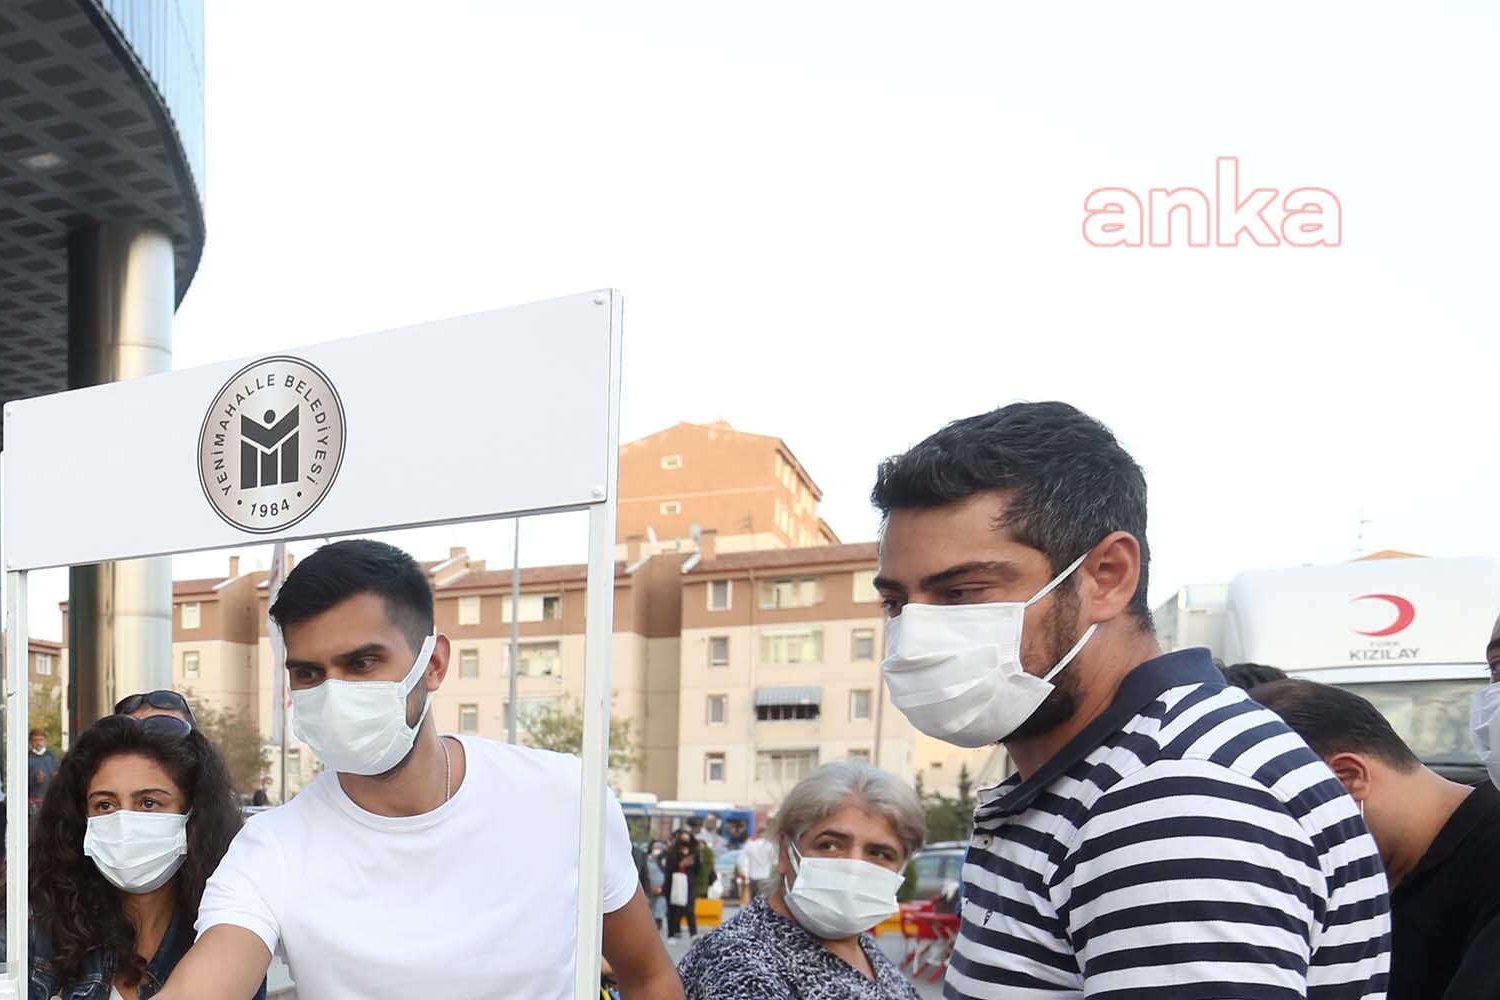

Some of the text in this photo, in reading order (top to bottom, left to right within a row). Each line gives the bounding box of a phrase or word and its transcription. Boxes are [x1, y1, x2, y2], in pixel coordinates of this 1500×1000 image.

[211, 374, 331, 496] YENİMAHALLE BELEDİYESİ
[251, 499, 290, 517] 1984
[1349, 648, 1420, 661] KIZILAY
